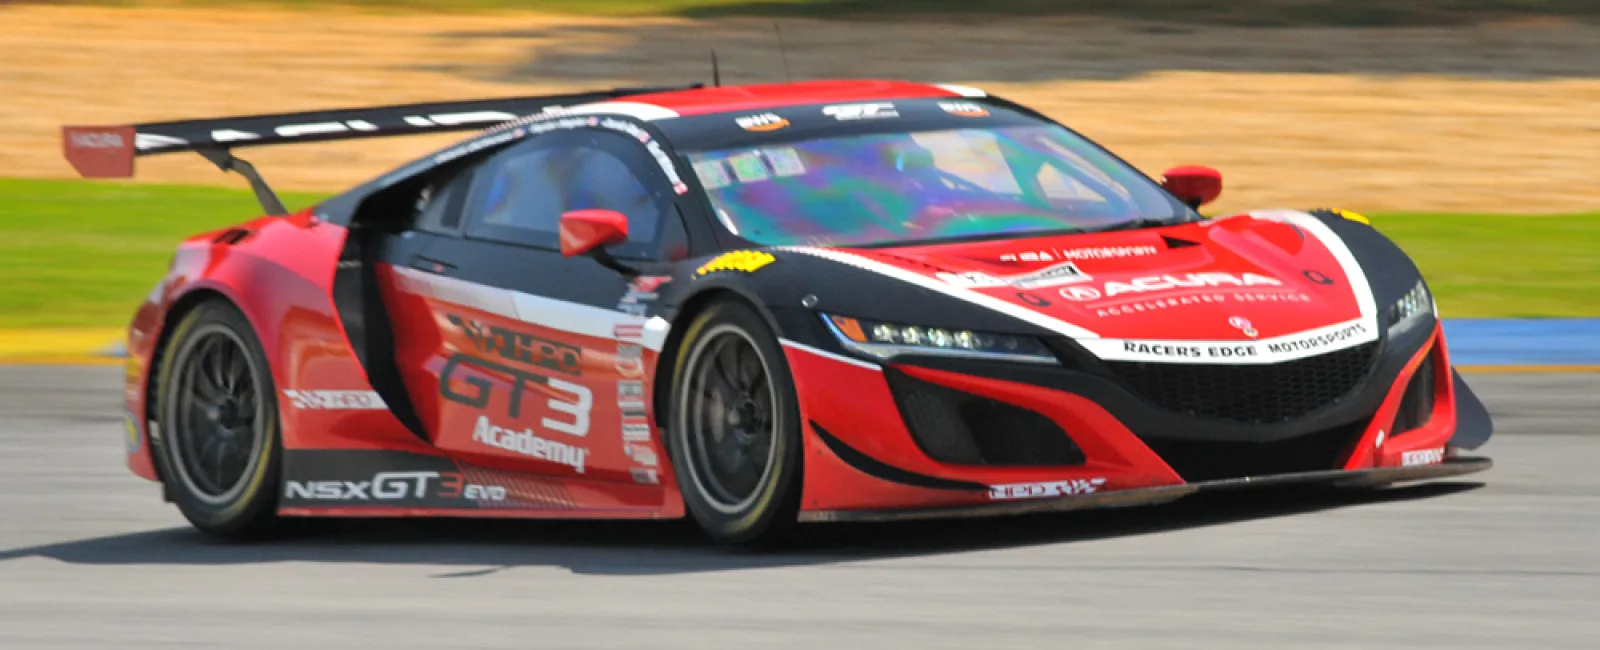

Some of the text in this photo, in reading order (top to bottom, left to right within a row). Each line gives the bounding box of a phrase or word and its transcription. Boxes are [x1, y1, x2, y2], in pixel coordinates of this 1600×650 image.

[1105, 272, 1283, 297] ACURA
[1123, 340, 1200, 357] RACERS
[1207, 346, 1258, 357] EDGE
[1268, 323, 1367, 353] MOTORSPORTS
[472, 415, 586, 473] Academy
